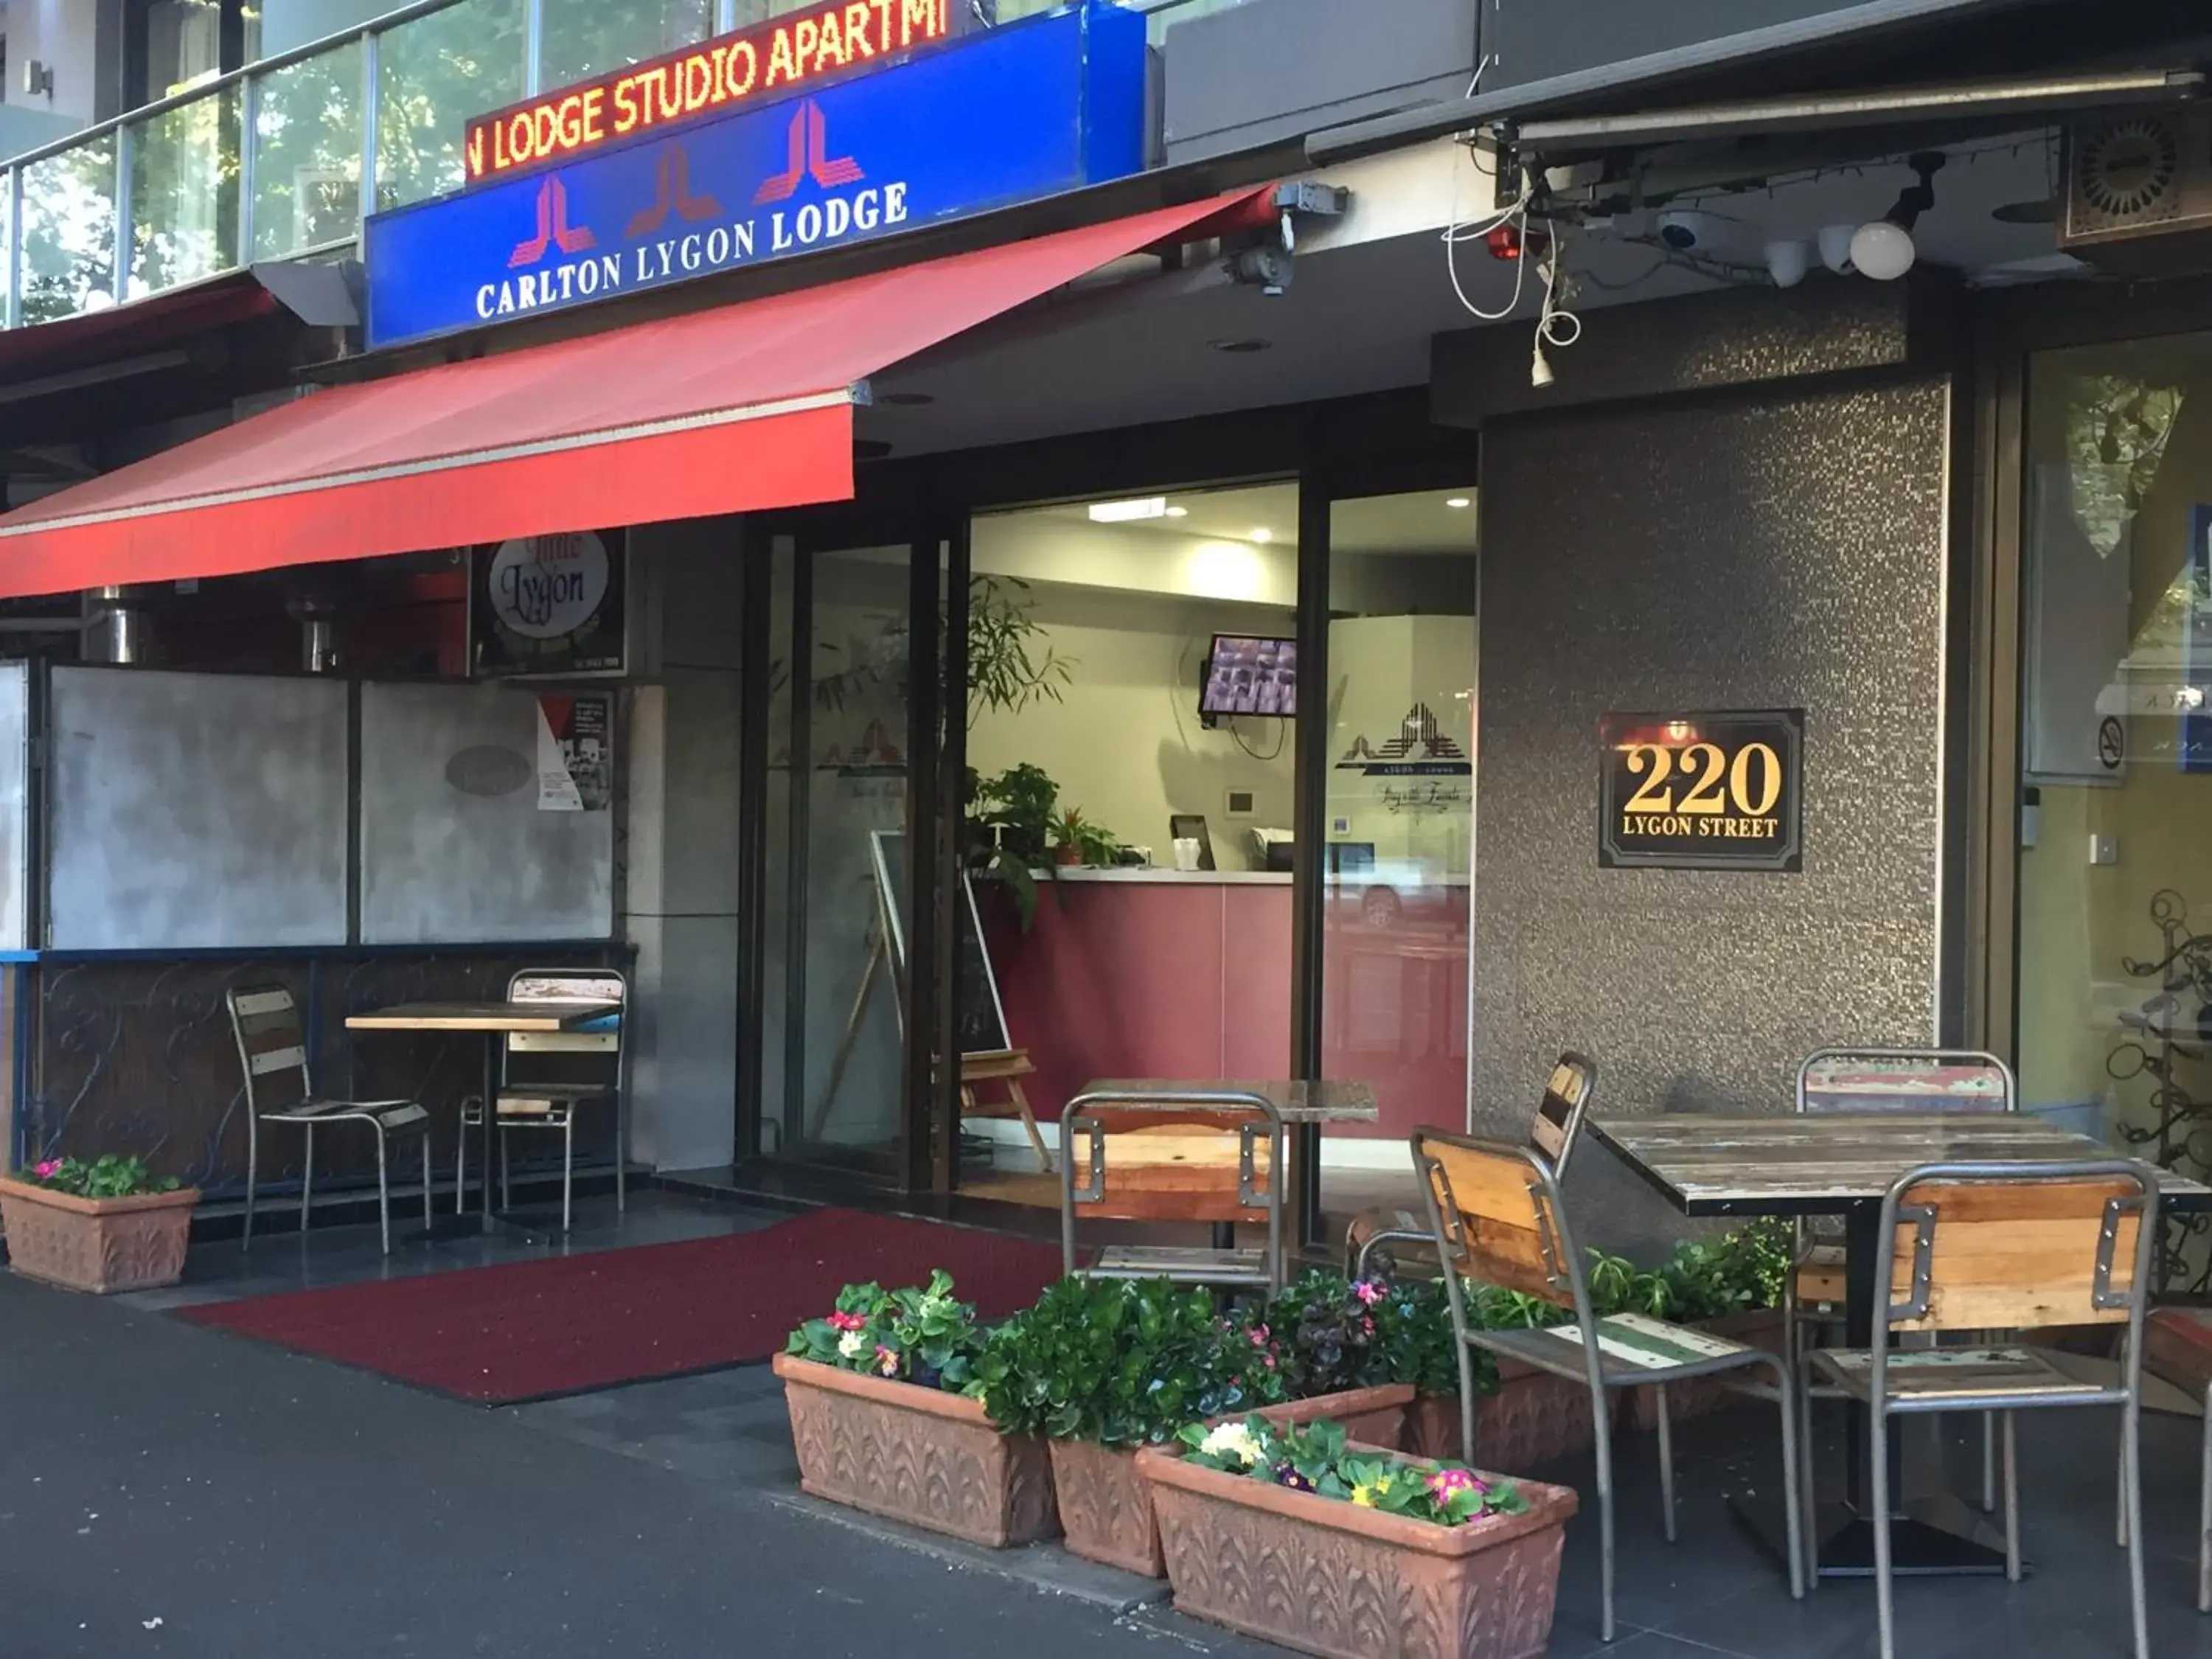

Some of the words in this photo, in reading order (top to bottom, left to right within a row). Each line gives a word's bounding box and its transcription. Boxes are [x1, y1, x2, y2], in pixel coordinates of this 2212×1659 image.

[495, 87, 605, 170] LODGE
[614, 40, 757, 134] STUDIO
[476, 253, 622, 319] CARLTON
[636, 220, 755, 282] LYGON
[771, 181, 908, 251] LODGE
[501, 564, 585, 626] Lygon
[1624, 742, 1782, 816] 220
[1623, 816, 1692, 836] LYGON
[1699, 818, 1778, 838] STREET
